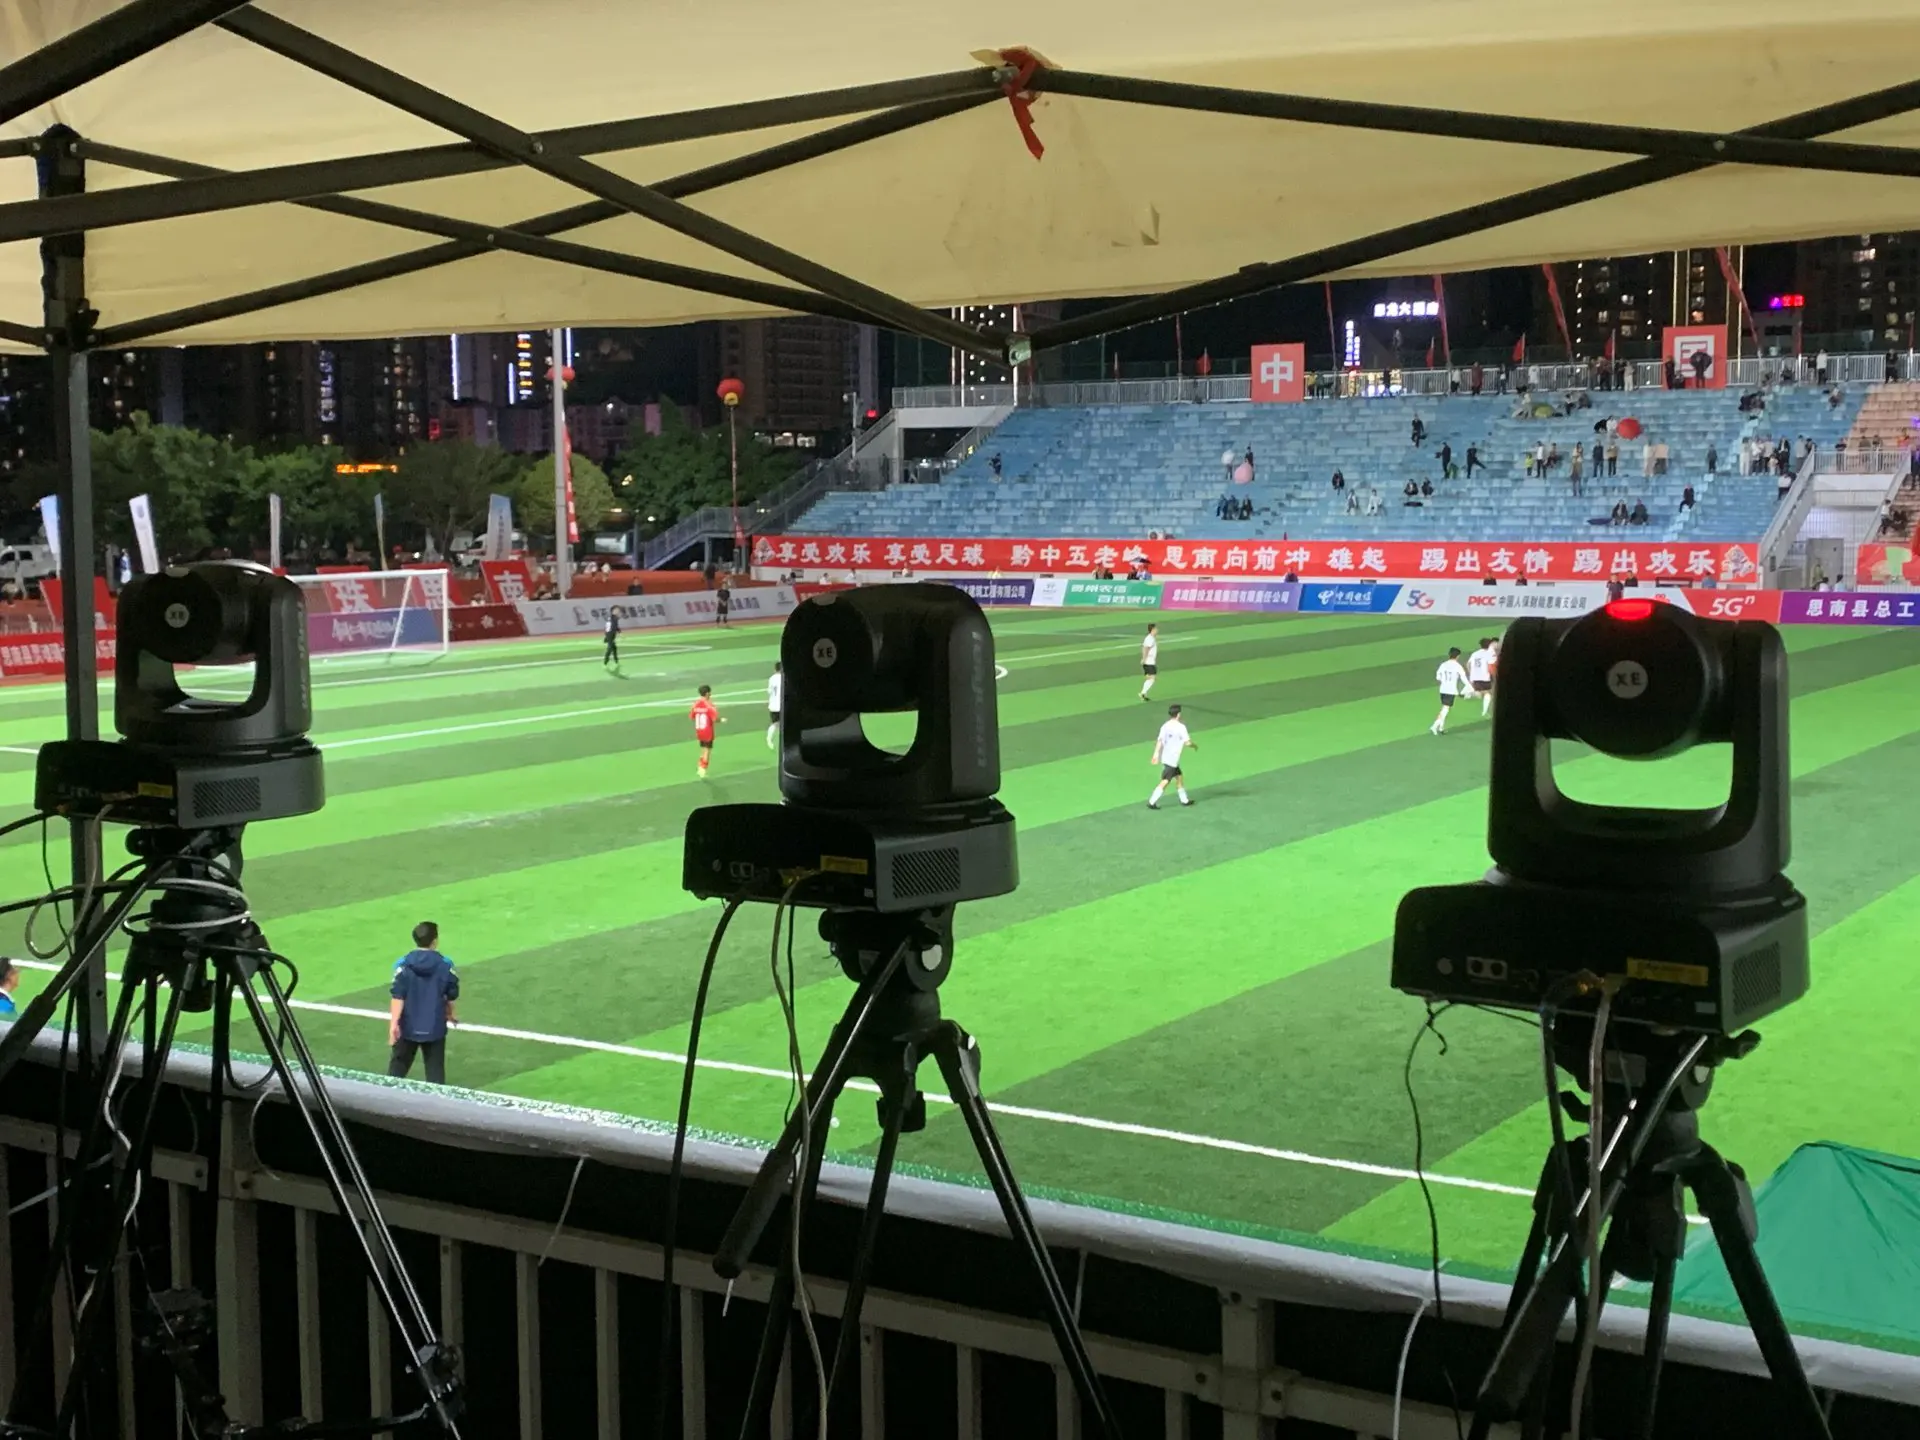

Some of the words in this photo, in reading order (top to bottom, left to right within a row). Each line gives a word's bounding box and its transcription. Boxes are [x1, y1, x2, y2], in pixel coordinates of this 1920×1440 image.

[1259, 352, 1296, 396] 中
[776, 542, 872, 564] 享受欢乐
[884, 543, 986, 566] 享受足球
[1010, 544, 1150, 569] 黔中五老峰
[1161, 546, 1312, 571] 思南向前冲
[1326, 547, 1389, 571] 雄起
[1419, 548, 1555, 574] 踢出友情
[1572, 549, 1716, 575] 踢出欢乐
[1406, 589, 1435, 610] 5G
[1467, 595, 1497, 606] PICC
[1806, 598, 1915, 618] 思南县总工
[1615, 672, 1642, 687] XE
